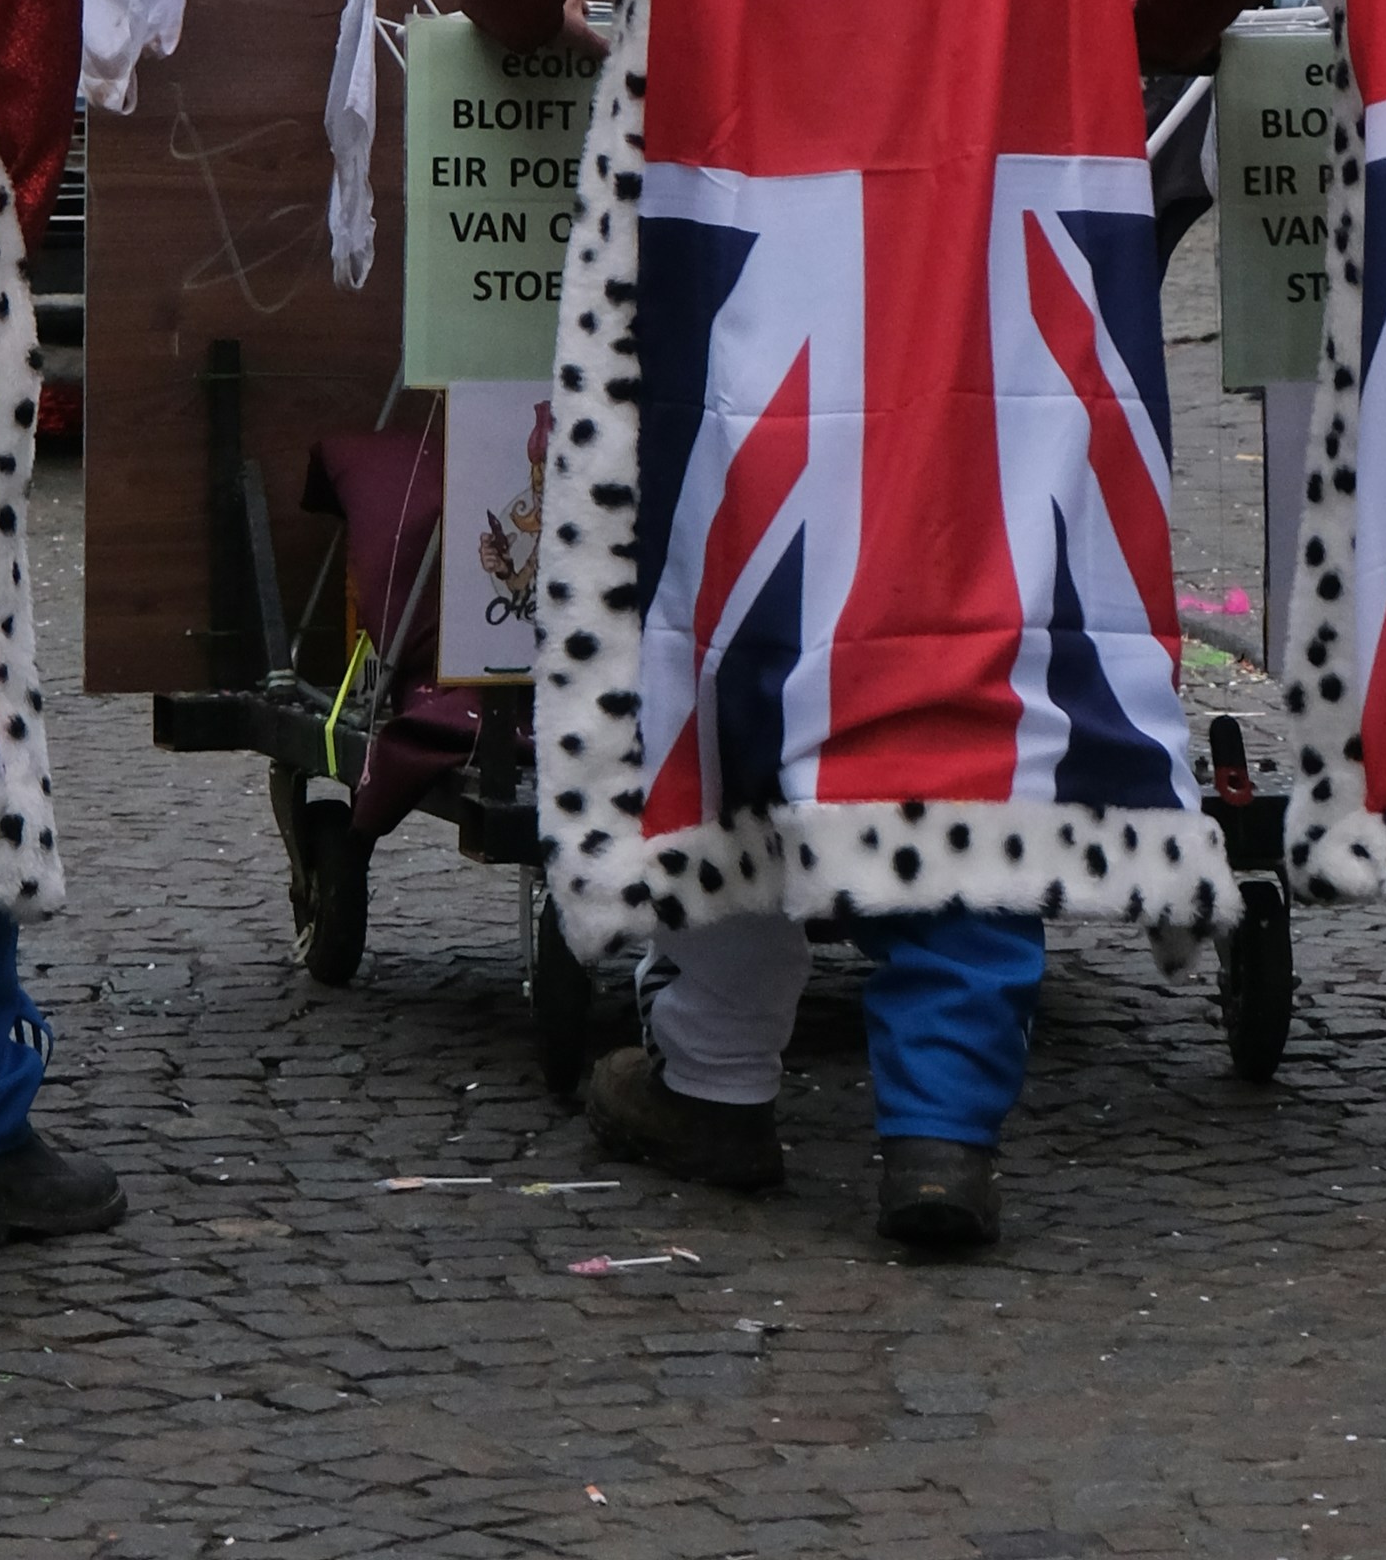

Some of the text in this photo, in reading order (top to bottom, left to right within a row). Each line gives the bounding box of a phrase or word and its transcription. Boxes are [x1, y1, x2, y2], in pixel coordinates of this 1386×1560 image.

[453, 99, 576, 130] BLOIFT
[432, 157, 487, 188] EIR
[1243, 166, 1297, 196] EIR
[449, 212, 526, 243] VAN
